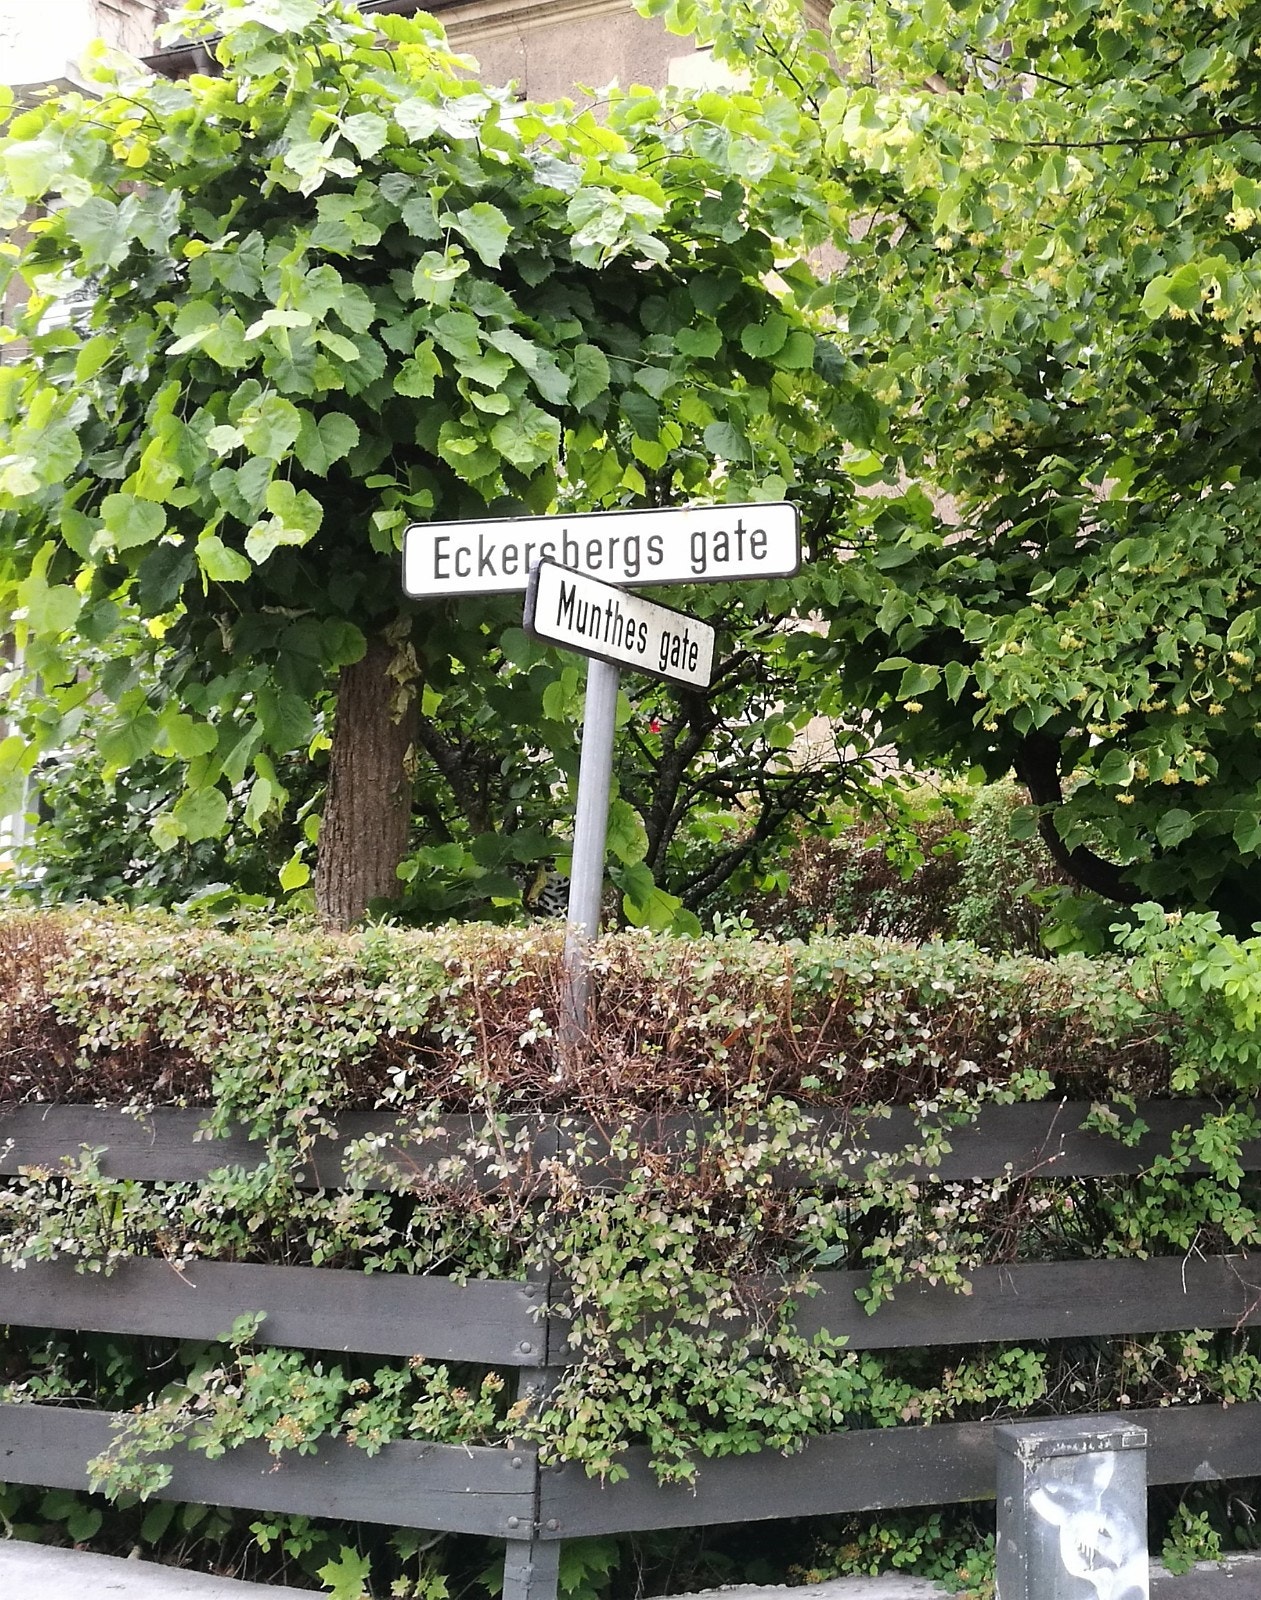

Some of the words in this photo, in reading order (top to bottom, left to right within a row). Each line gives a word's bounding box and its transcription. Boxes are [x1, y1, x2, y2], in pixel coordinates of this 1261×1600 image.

[434, 529, 663, 579] Eckersbergs
[690, 519, 767, 574] gate
[556, 580, 648, 654] Munthes
[658, 628, 698, 672] gate
